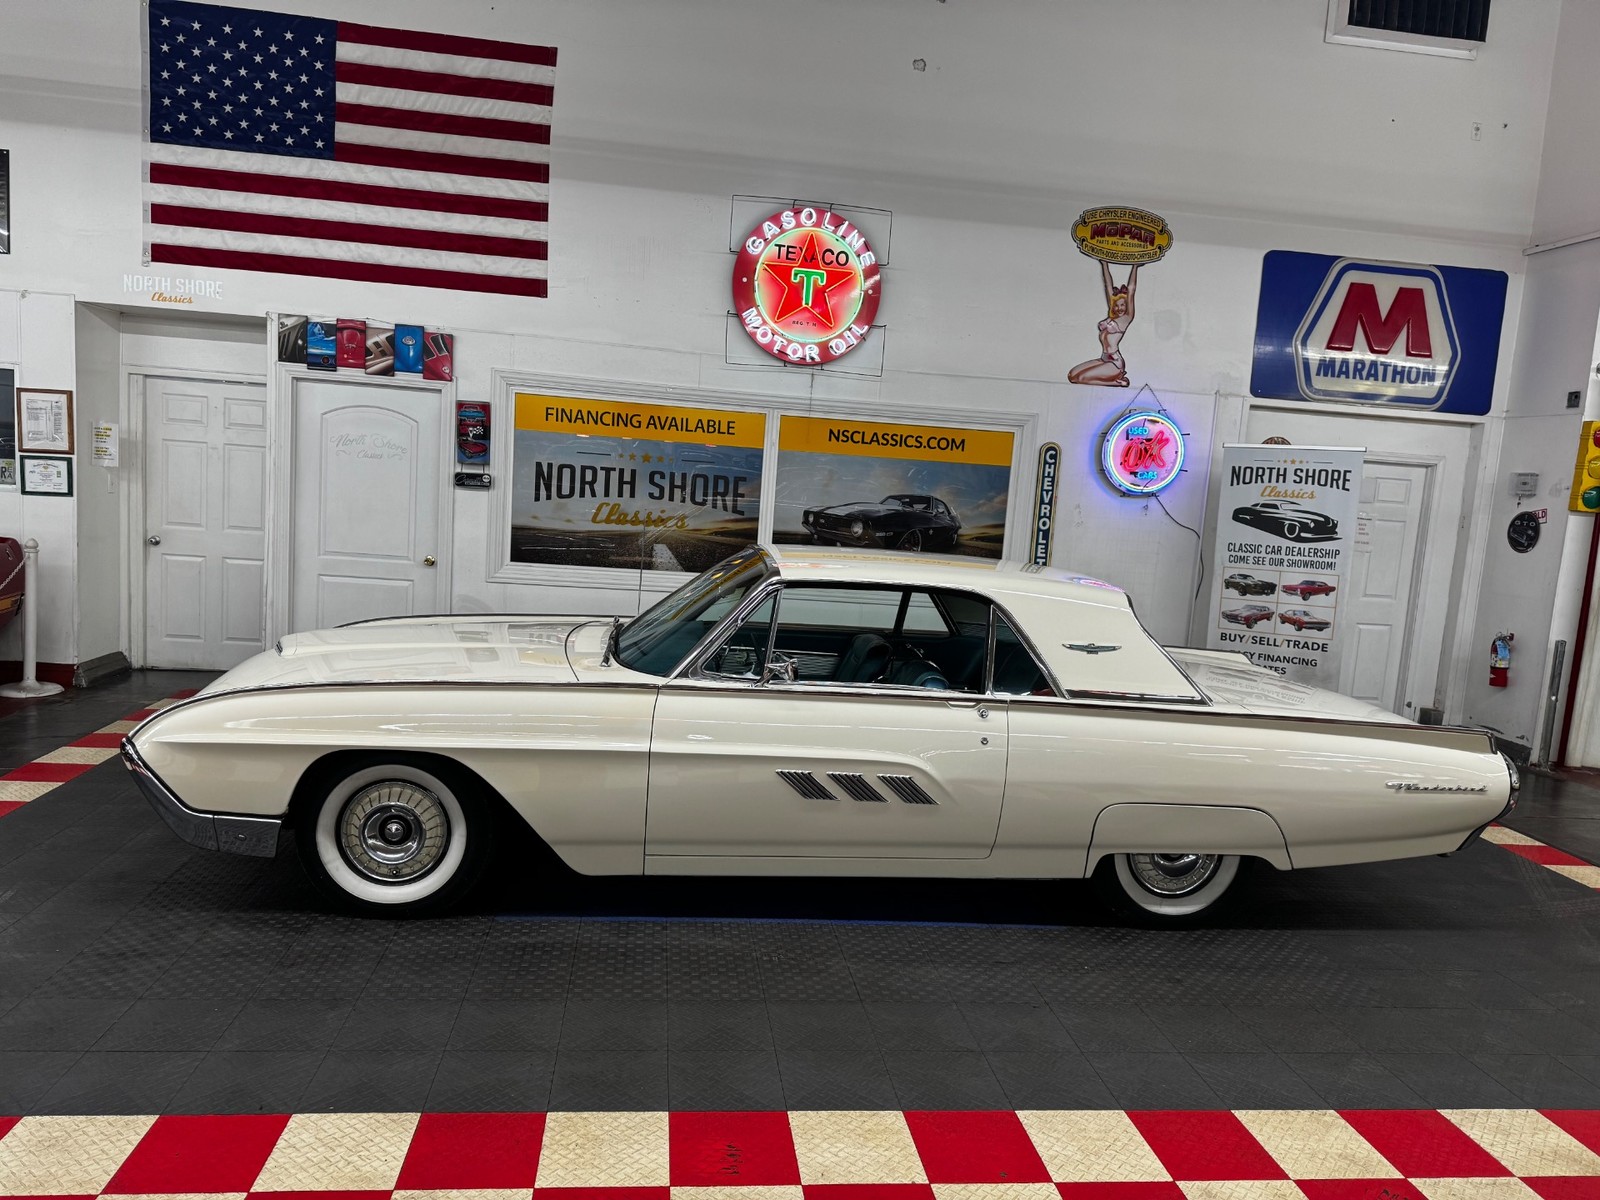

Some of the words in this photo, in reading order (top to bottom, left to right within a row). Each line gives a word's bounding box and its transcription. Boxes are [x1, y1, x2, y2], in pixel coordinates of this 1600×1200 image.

[1086, 211, 1098, 220] USE
[1100, 210, 1127, 219] CHRYSLER
[1128, 211, 1160, 227] ENGINEERED
[746, 208, 875, 269] GASOLINE
[1090, 222, 1156, 247] MOPAR
[1121, 241, 1149, 249] ACCESSORIES
[774, 243, 850, 266] TEXACO
[123, 274, 171, 293] NORTH
[176, 278, 224, 300] SHORE
[151, 291, 194, 304] Classics
[791, 268, 826, 307] T
[1325, 282, 1432, 359] M
[742, 307, 821, 363] MOTOR
[829, 324, 868, 355] OIL
[1315, 356, 1437, 385] MARATHON
[545, 407, 642, 429] FINANCING
[645, 415, 736, 436] AVAILABLE
[1128, 427, 1149, 435] USED
[330, 433, 368, 448] North
[370, 433, 408, 454] Shore
[828, 428, 966, 452] NSCLASSICS.COM
[1121, 430, 1170, 472] OK
[1137, 471, 1157, 479] CARS
[1230, 465, 1287, 487] NORTH
[1292, 468, 1352, 492] SHORE
[534, 461, 637, 502] NORTH
[648, 470, 748, 516] SHORE
[1260, 485, 1317, 500] Classics
[591, 502, 690, 529] Classics
[1036, 450, 1056, 566] CHEVROLET
[1227, 542, 1263, 555] CLASSIC
[1264, 545, 1283, 556] CAR
[1284, 546, 1341, 560] DEALERSHIP
[1228, 554, 1250, 565] COME
[1252, 556, 1267, 566] SEE
[1268, 557, 1284, 567] OUR
[1286, 559, 1337, 571] SHOWROOM!
[1220, 632, 1329, 652] BUY/SELL/TRADE
[1257, 653, 1318, 667] FINANCING
